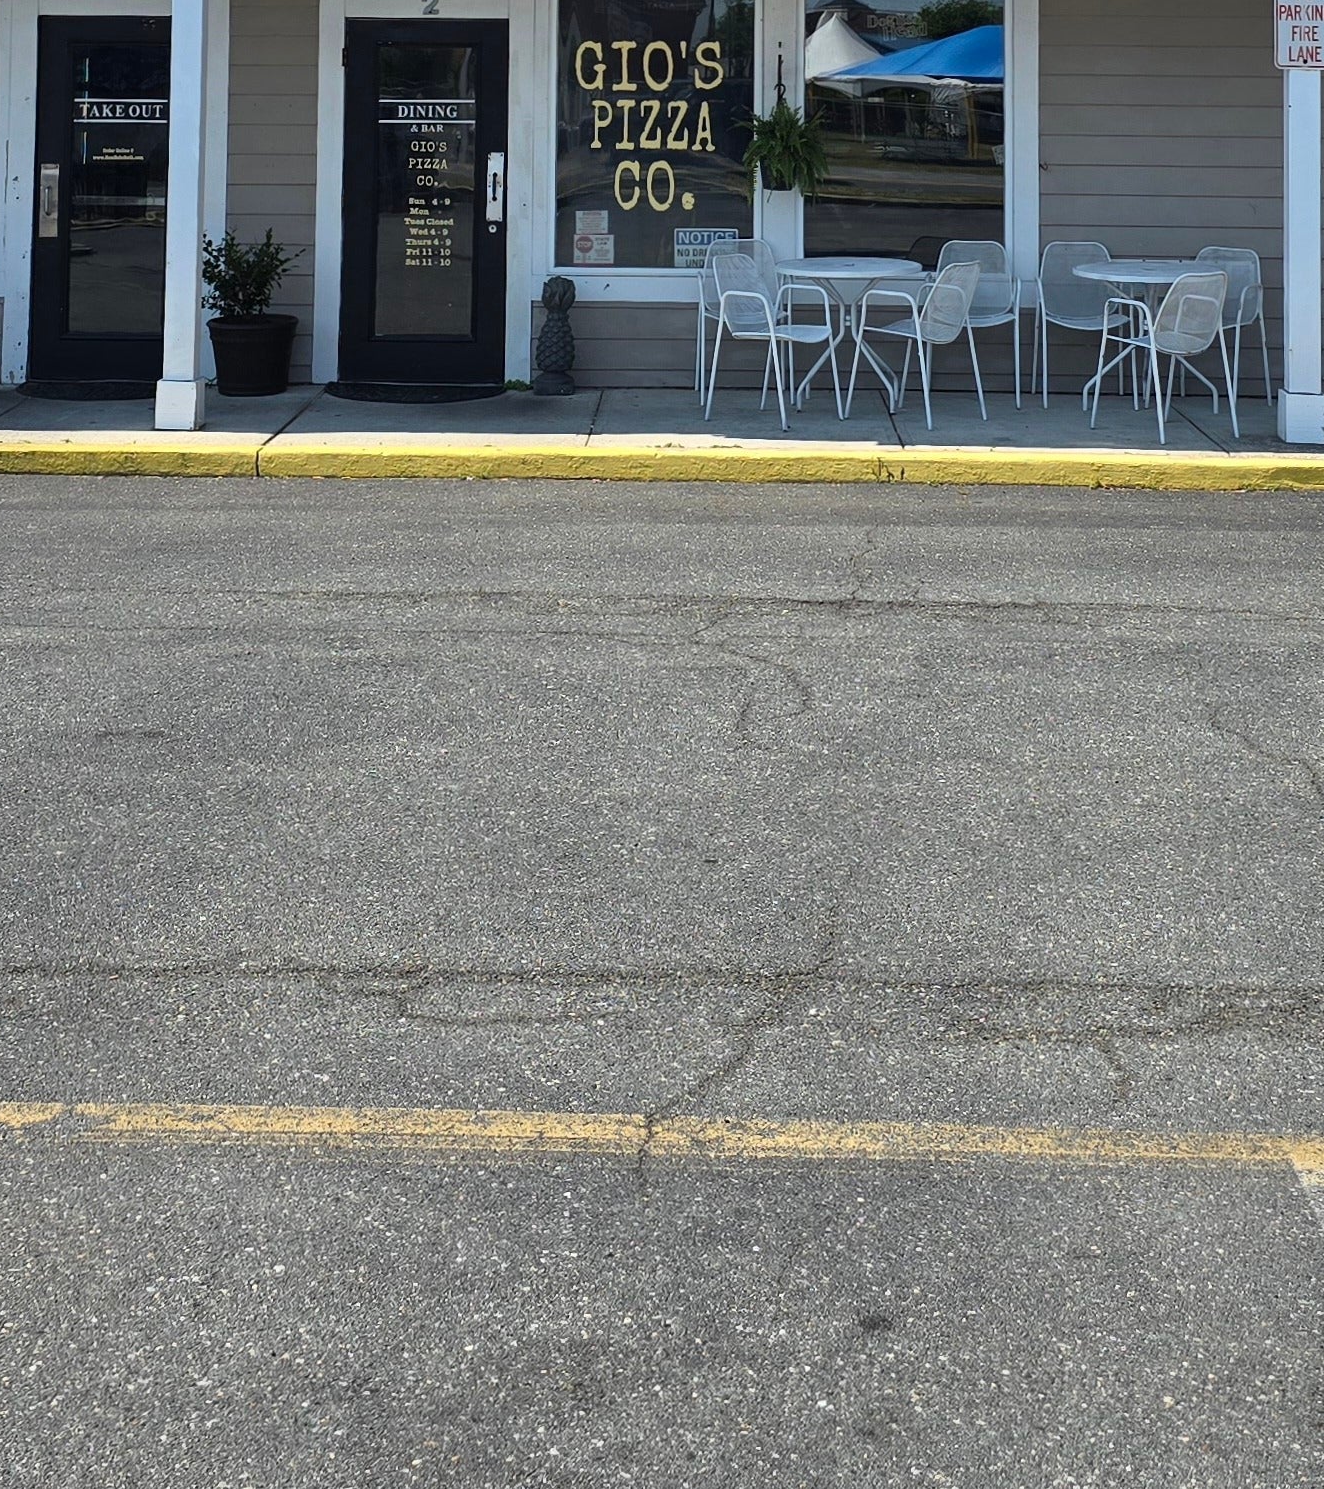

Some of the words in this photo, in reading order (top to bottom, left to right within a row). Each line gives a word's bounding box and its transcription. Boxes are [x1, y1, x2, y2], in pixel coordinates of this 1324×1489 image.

[1292, 25, 1319, 42] FIRE
[1288, 45, 1322, 63] LANE
[575, 40, 724, 91] GIO'S
[79, 104, 125, 118] TAKE
[128, 104, 163, 118] OUT
[397, 105, 458, 118] DINING
[410, 124, 419, 133] &
[421, 124, 444, 133] BAR
[590, 99, 716, 152] PIZZA
[410, 141, 448, 152] GIO'S
[408, 158, 448, 170] PIZZA
[416, 175, 439, 186] CO.
[612, 160, 696, 212] CO.
[408, 197, 426, 205] Sun
[409, 207, 429, 215] Mon
[678, 231, 734, 244] NOTICE
[405, 248, 420, 256] Fri
[421, 248, 432, 256] 11
[440, 248, 451, 256] 10
[677, 248, 690, 257] NO
[405, 258, 420, 266] Sat
[421, 258, 432, 266] 11
[440, 258, 451, 266] 10
